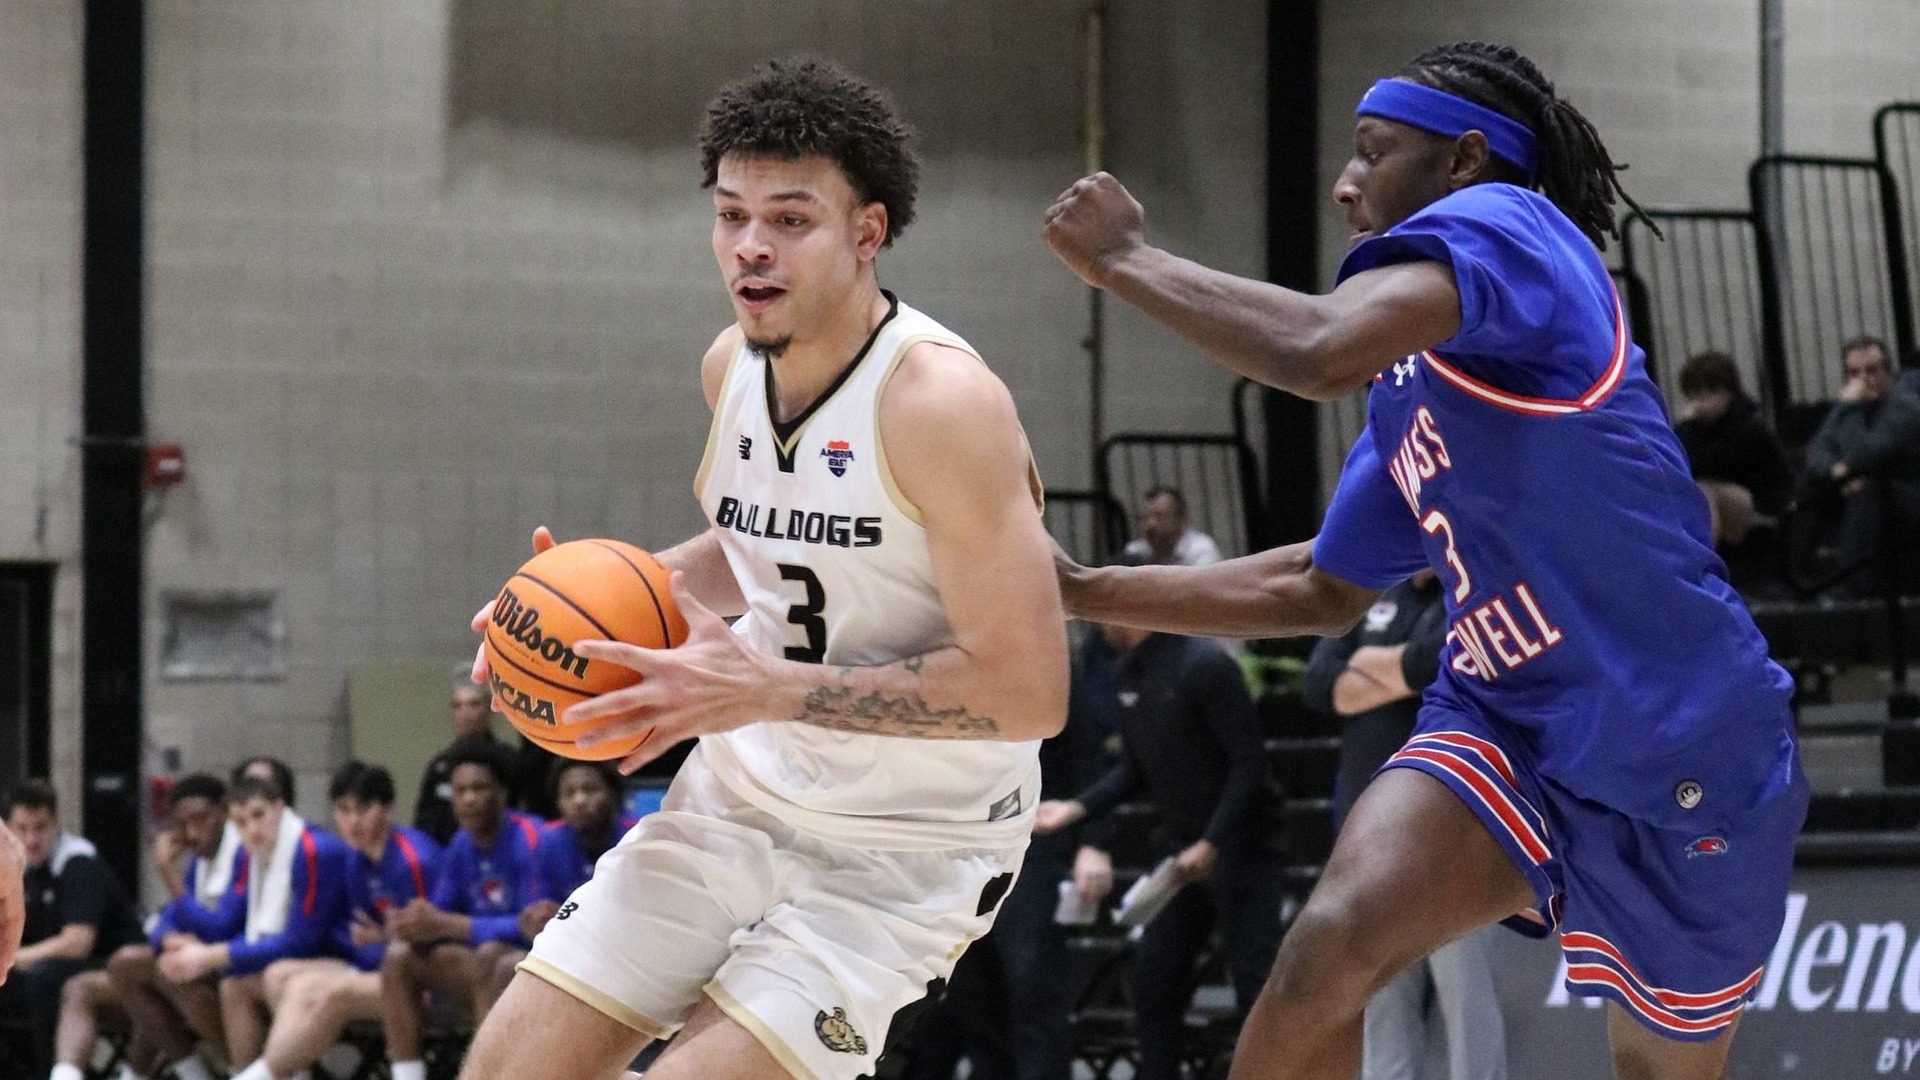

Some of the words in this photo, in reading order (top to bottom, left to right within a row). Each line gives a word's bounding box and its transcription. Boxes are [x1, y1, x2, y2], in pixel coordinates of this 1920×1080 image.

[716, 496, 882, 547] BULLDOGS
[1420, 508, 1471, 606] 3
[492, 586, 590, 680] Wilson
[776, 562, 827, 664] 3
